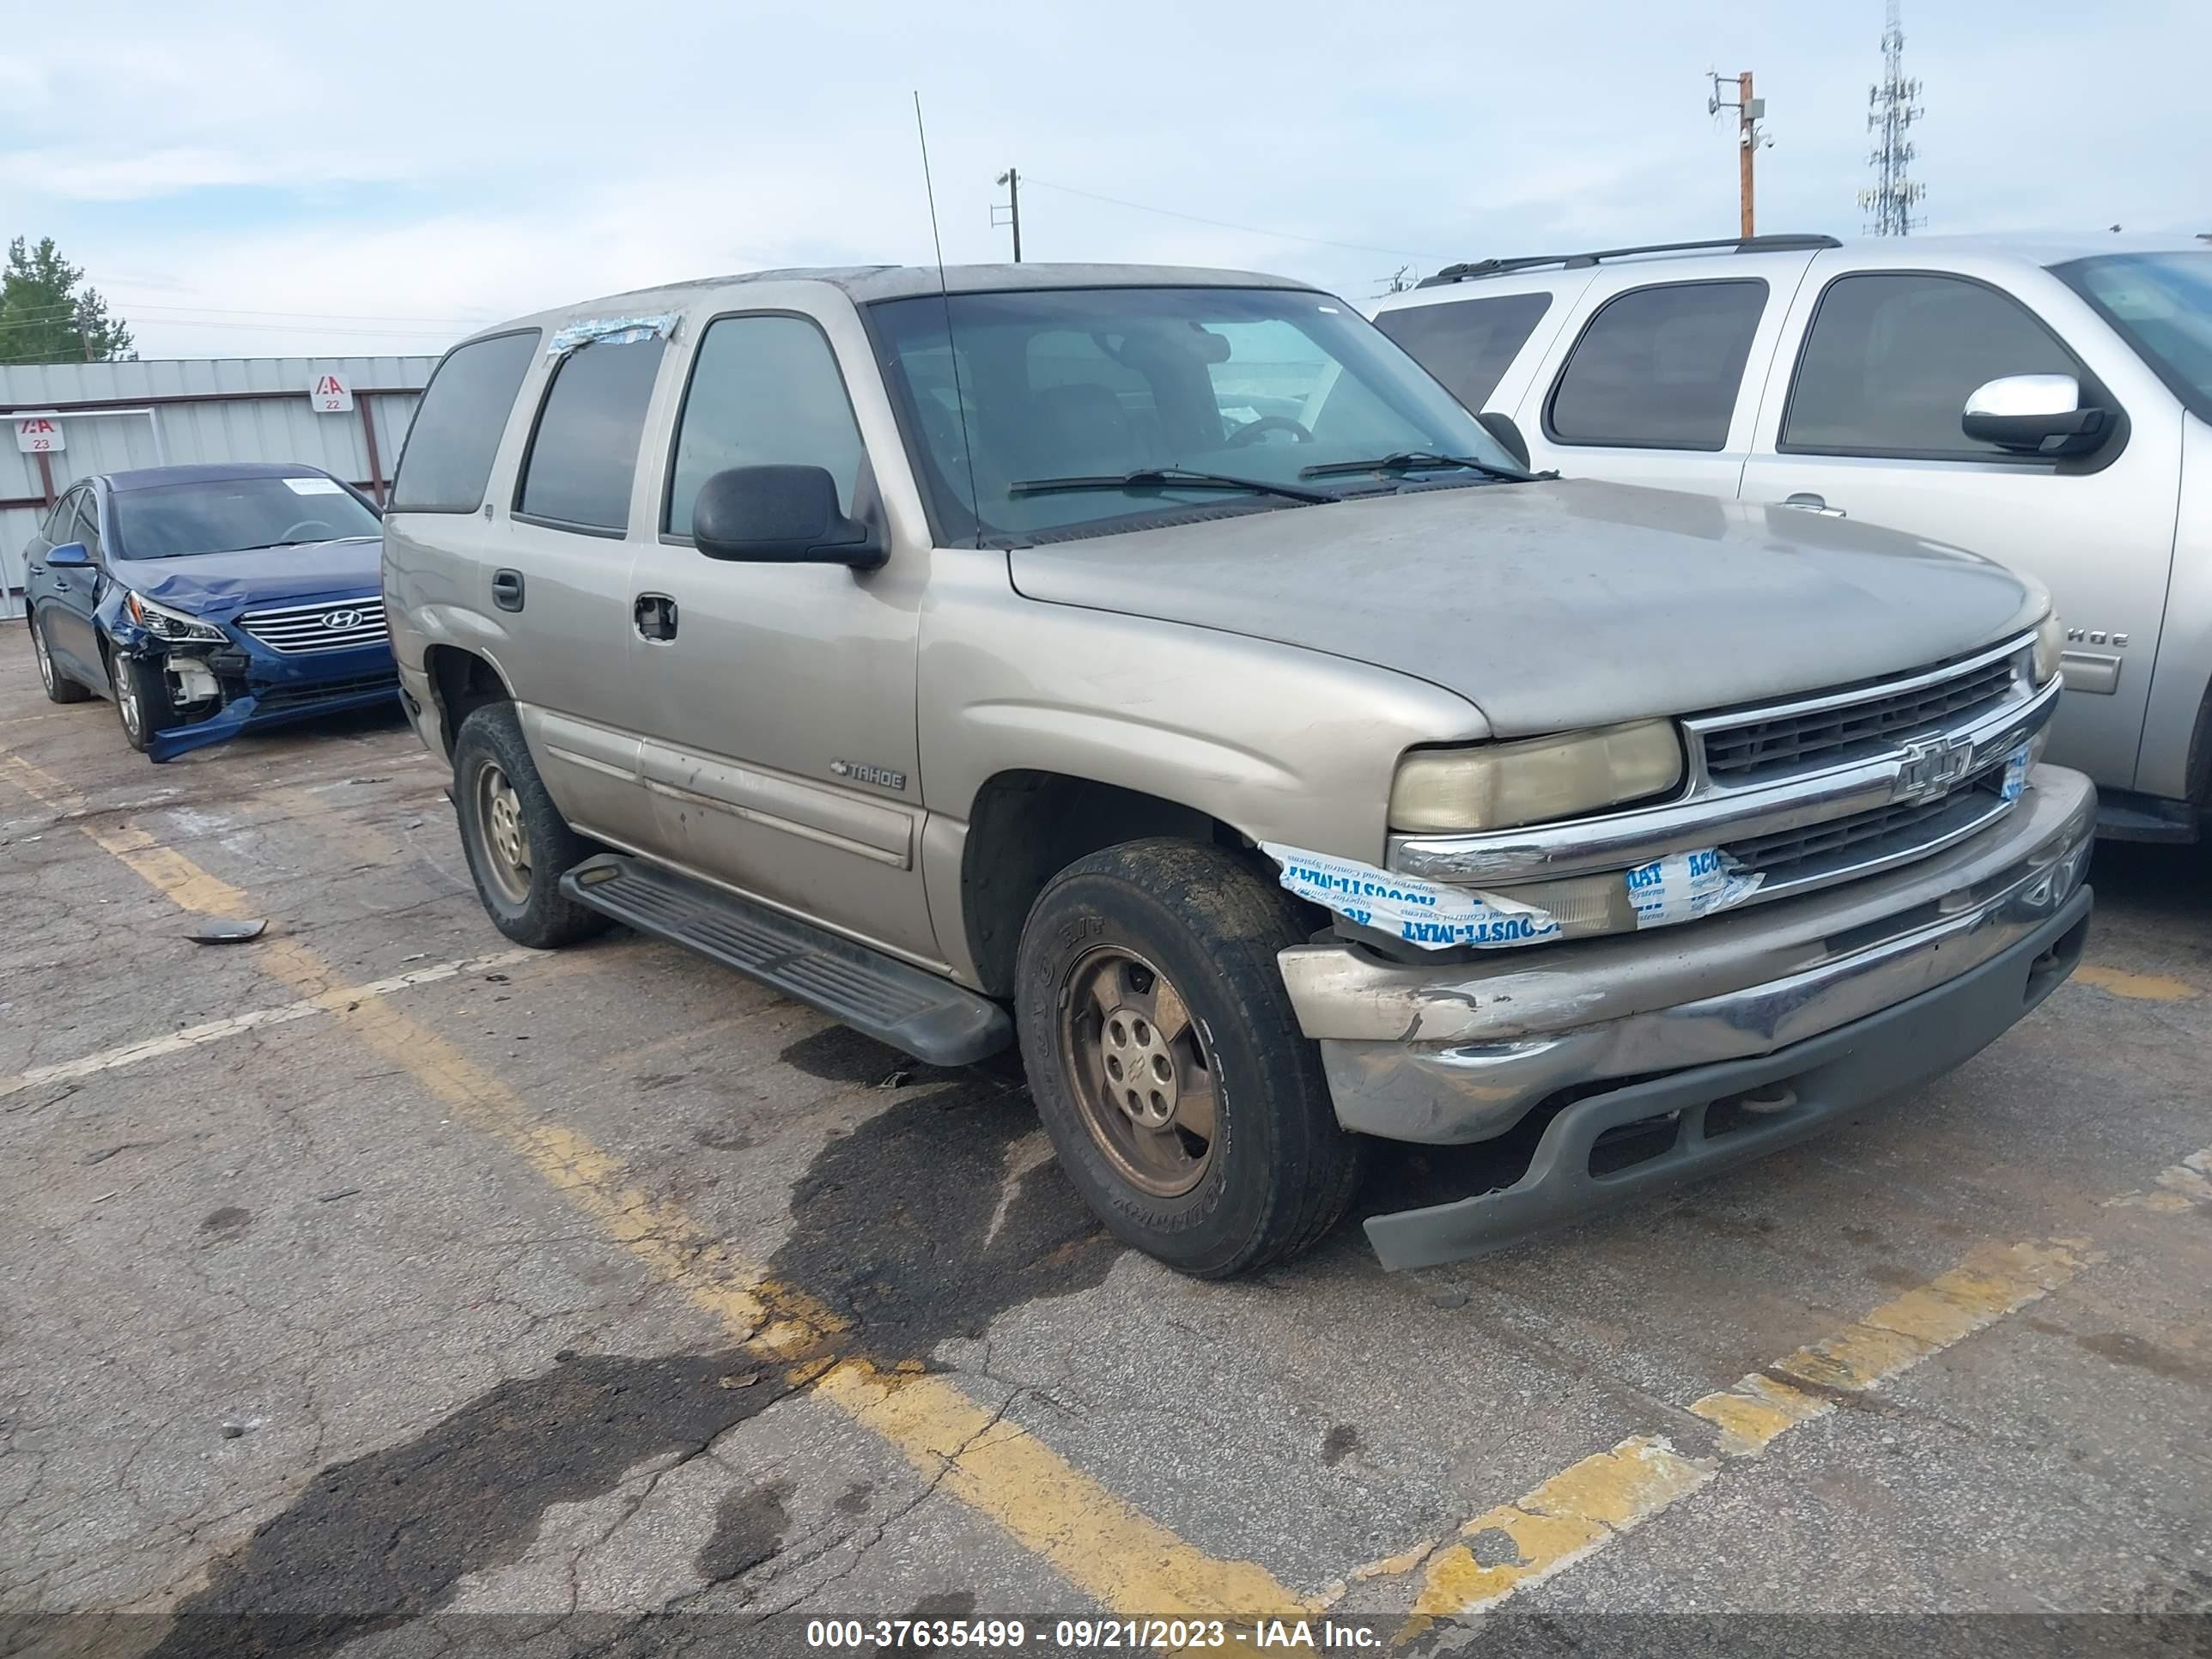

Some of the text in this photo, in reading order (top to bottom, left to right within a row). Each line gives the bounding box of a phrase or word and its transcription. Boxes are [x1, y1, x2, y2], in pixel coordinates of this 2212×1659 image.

[325, 399, 341, 410] 22
[33, 439, 50, 449] 23
[849, 763, 903, 789] TAHOE
[1286, 855, 1436, 894] Superior Sound Control Systems
[1331, 893, 1371, 909] Superior
[1401, 909, 1441, 921] Systems
[1443, 913, 1486, 921] Control
